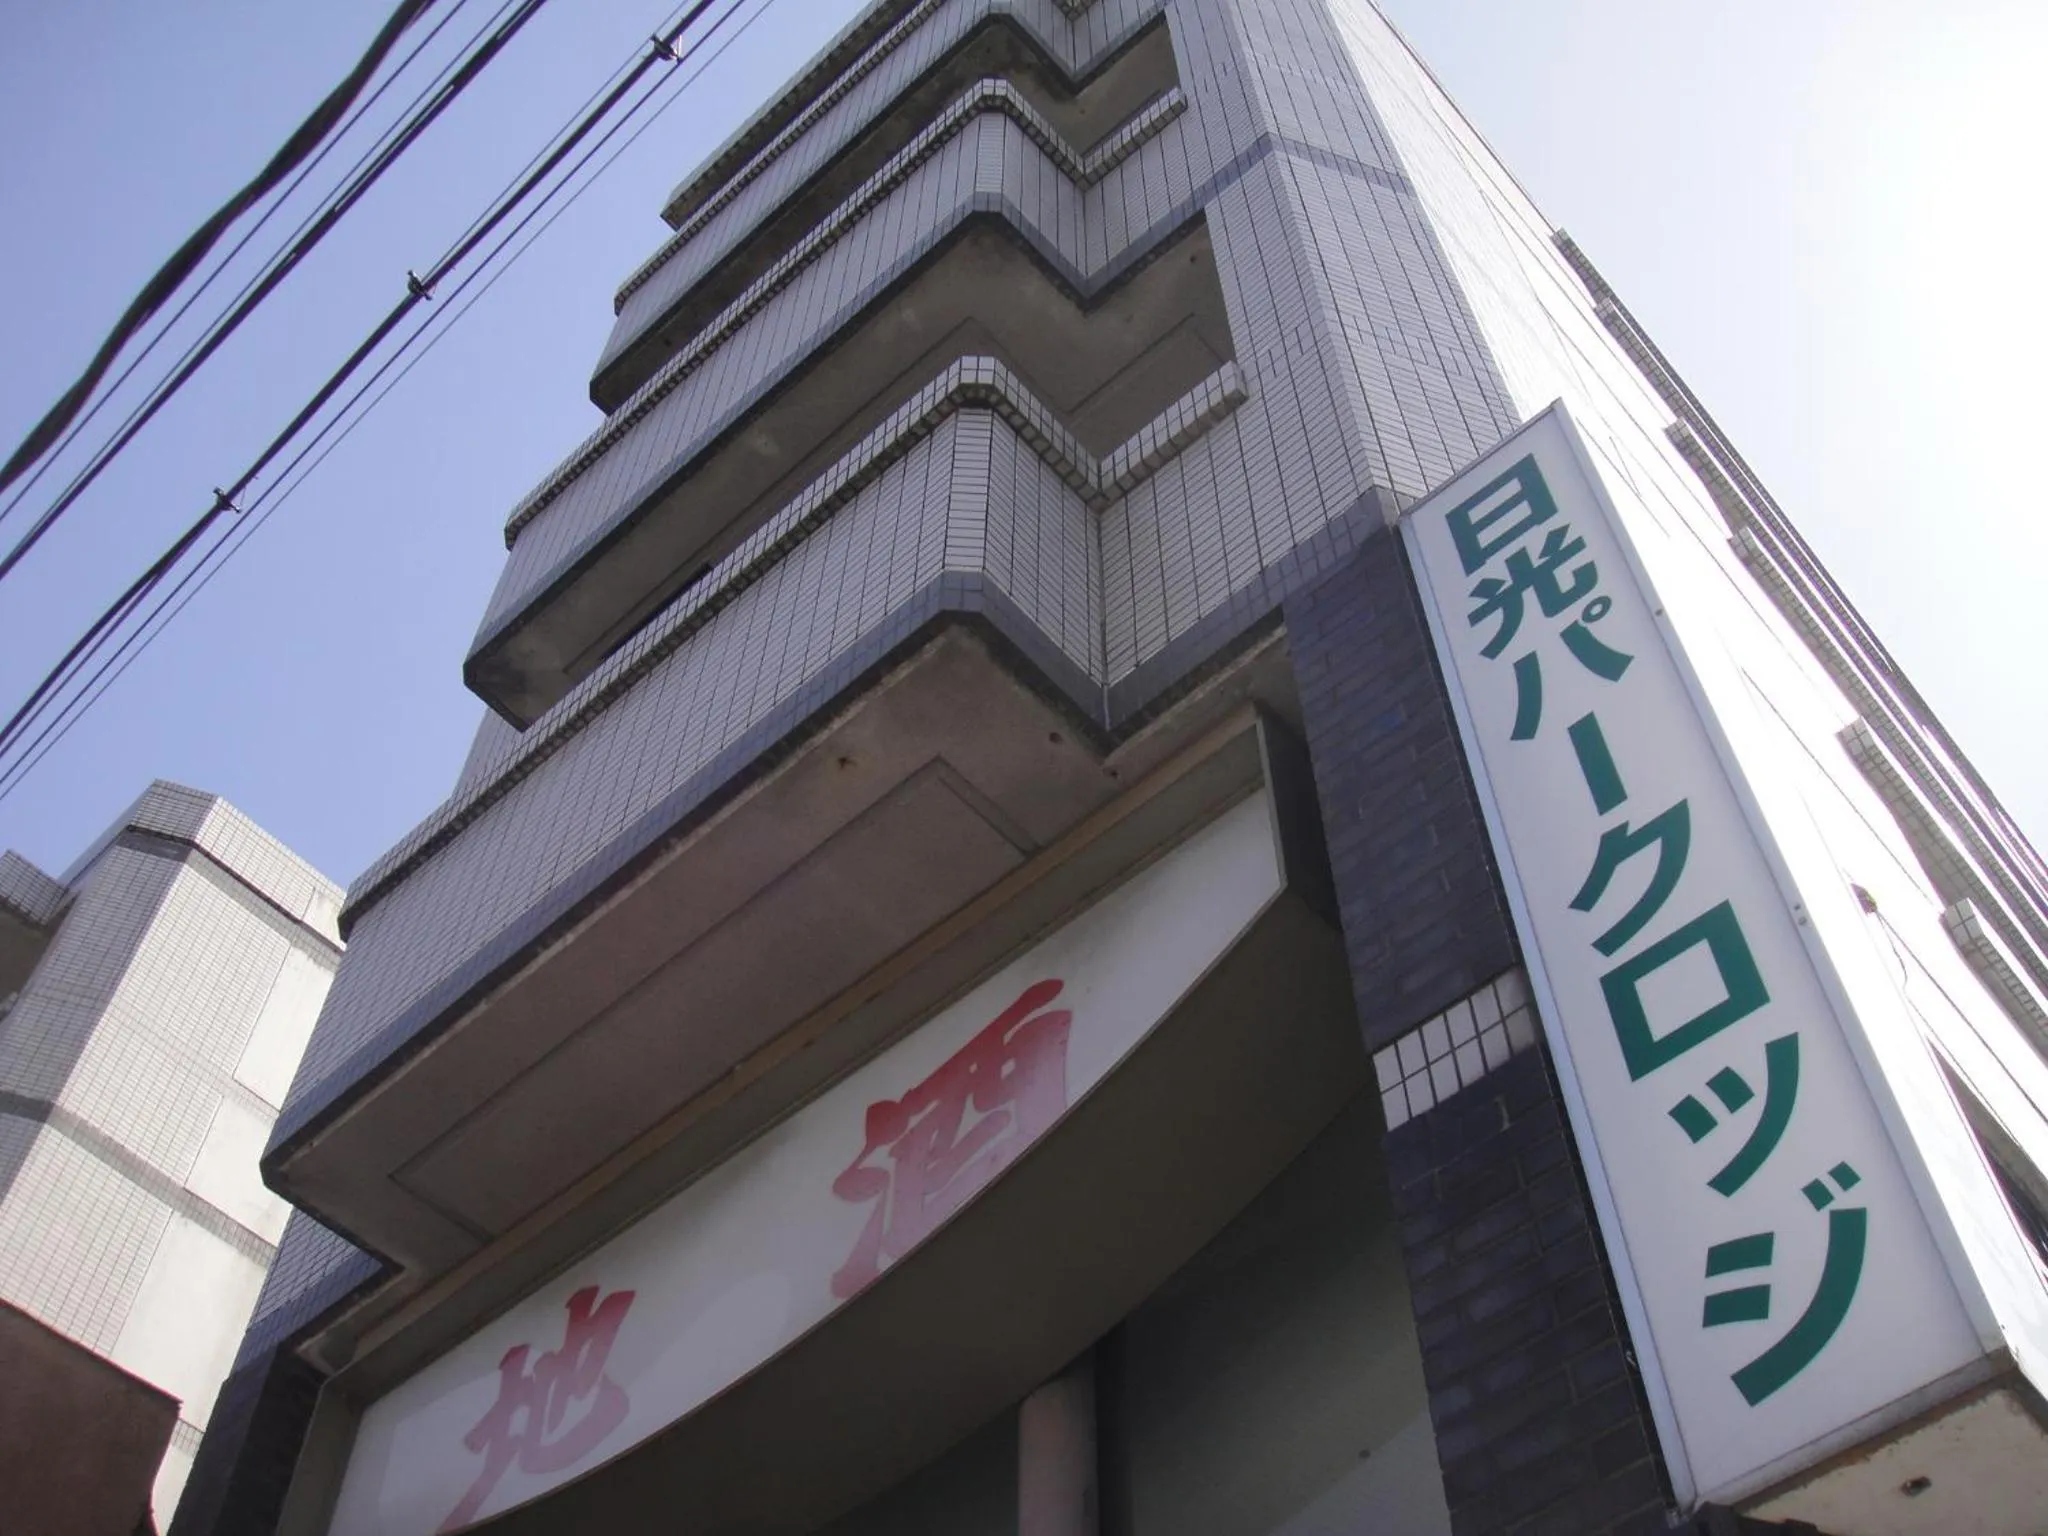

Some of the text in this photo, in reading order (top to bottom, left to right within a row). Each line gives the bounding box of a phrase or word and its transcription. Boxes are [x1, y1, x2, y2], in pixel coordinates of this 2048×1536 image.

[1445, 452, 1868, 1408] 日光パークロッジ
